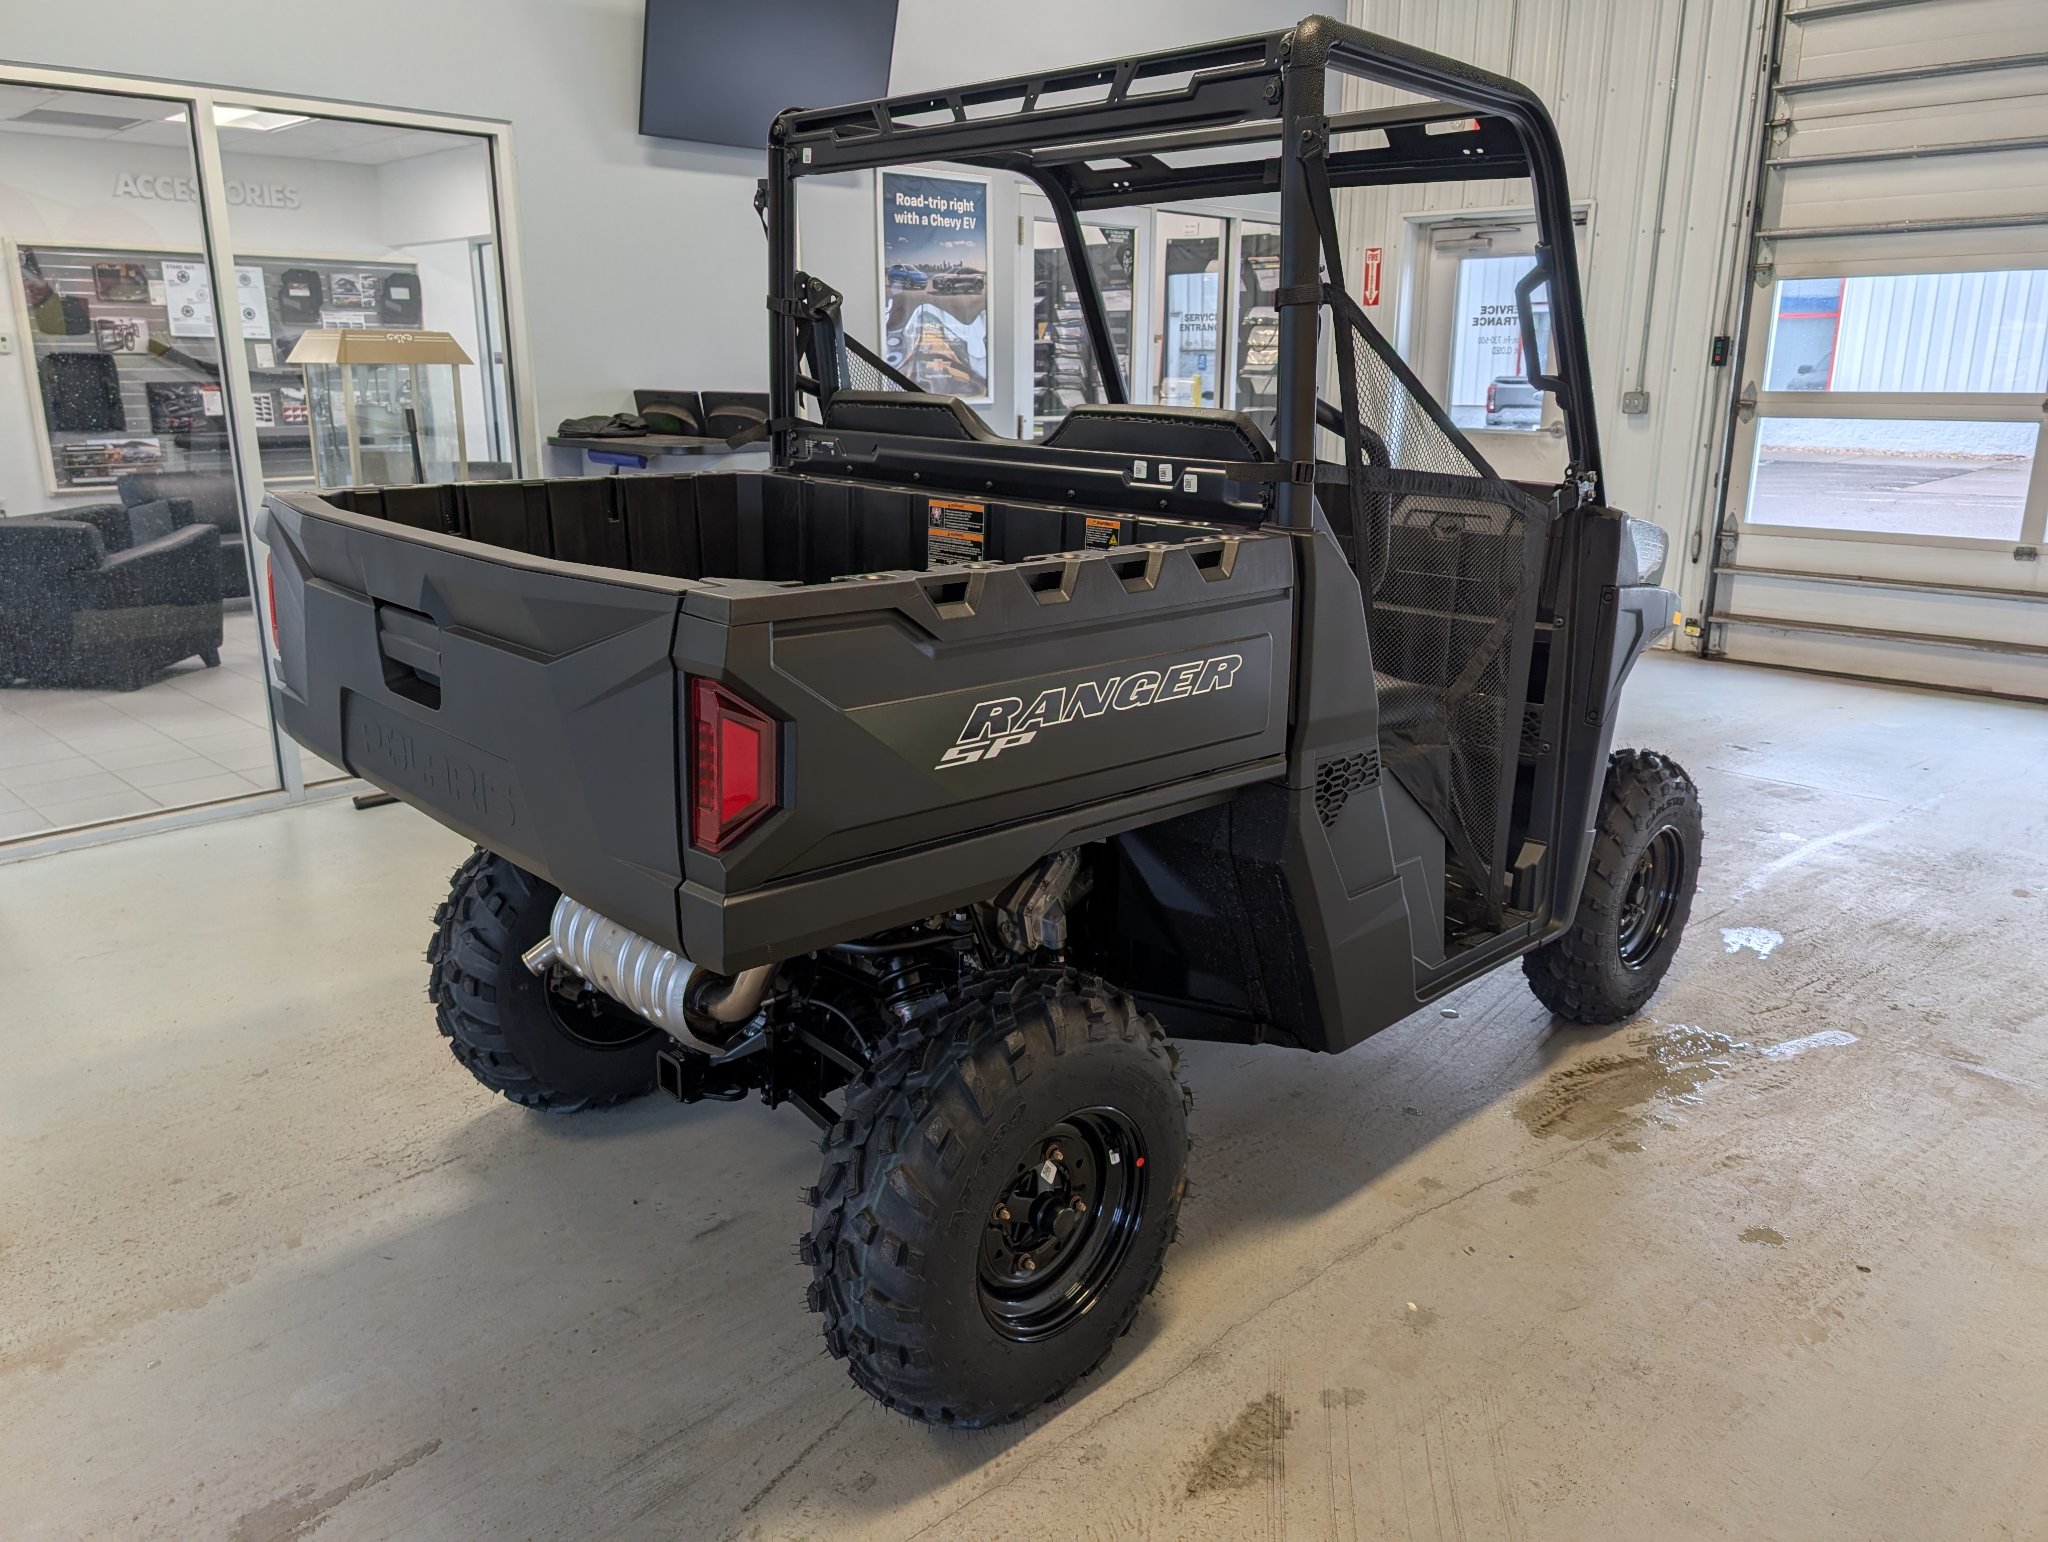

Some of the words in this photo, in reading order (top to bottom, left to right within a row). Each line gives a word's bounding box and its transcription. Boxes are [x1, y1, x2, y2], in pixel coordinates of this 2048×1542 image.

[113, 173, 301, 209] ACCESORIES
[895, 192, 948, 212] Road-trip
[949, 198, 975, 214] right
[894, 211, 920, 225] with
[921, 215, 929, 226] a
[930, 213, 962, 231] Chevy
[963, 216, 977, 230] EV
[1368, 253, 1379, 262] FIRE
[1184, 313, 1217, 322] SERVIC
[956, 653, 1243, 745] RANGER
[934, 730, 1038, 770] SP
